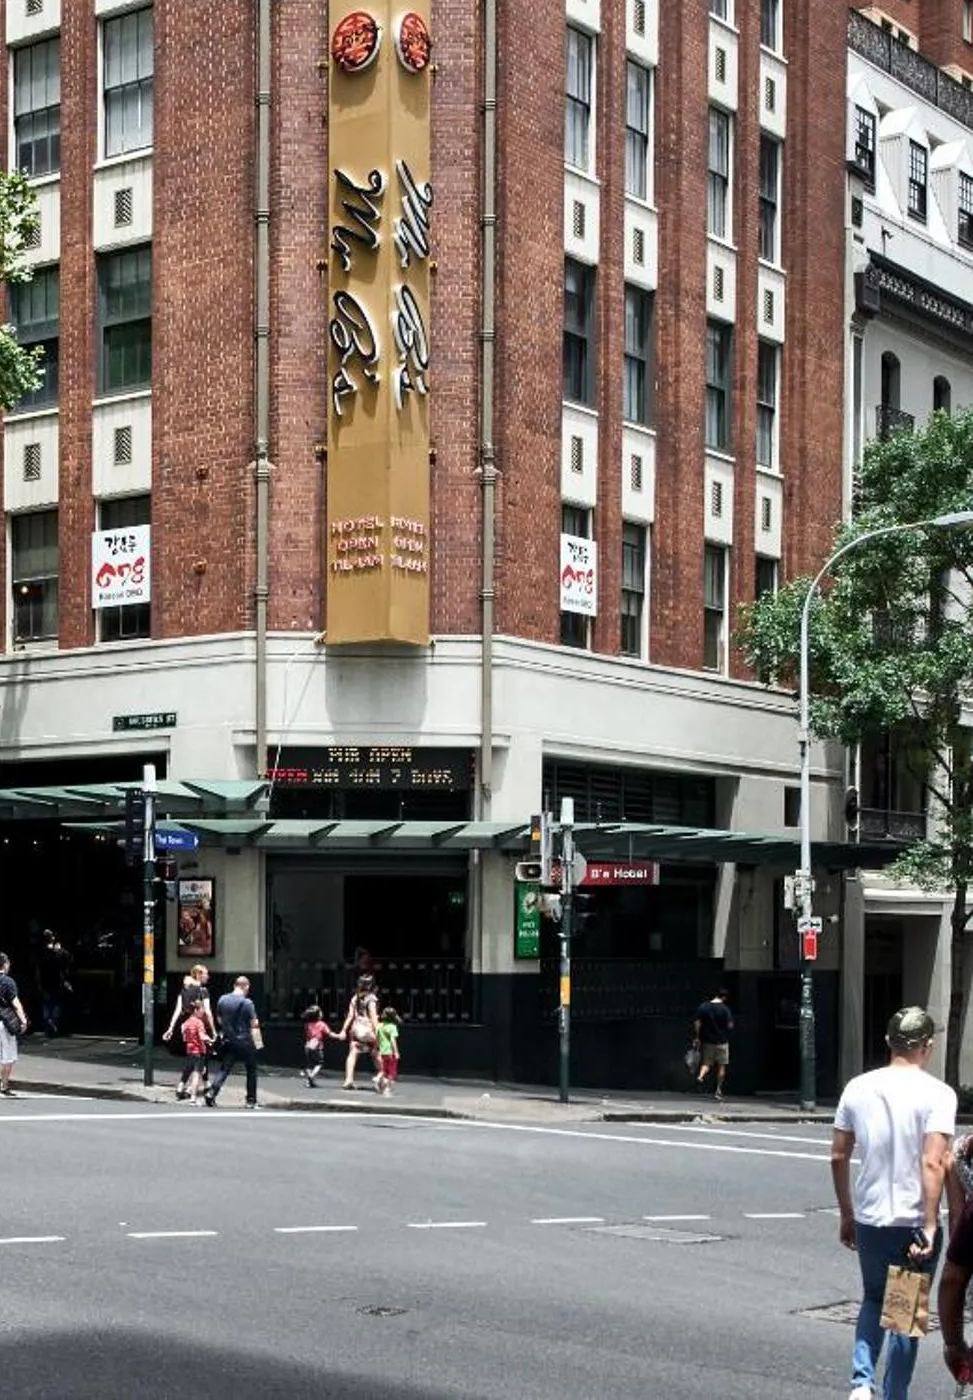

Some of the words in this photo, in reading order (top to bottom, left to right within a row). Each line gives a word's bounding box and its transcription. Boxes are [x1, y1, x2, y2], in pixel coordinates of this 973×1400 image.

[332, 516, 384, 533] HOTEL
[338, 536, 379, 551] OPEN
[369, 748, 412, 763] OPEN
[614, 869, 647, 878] Hotel
